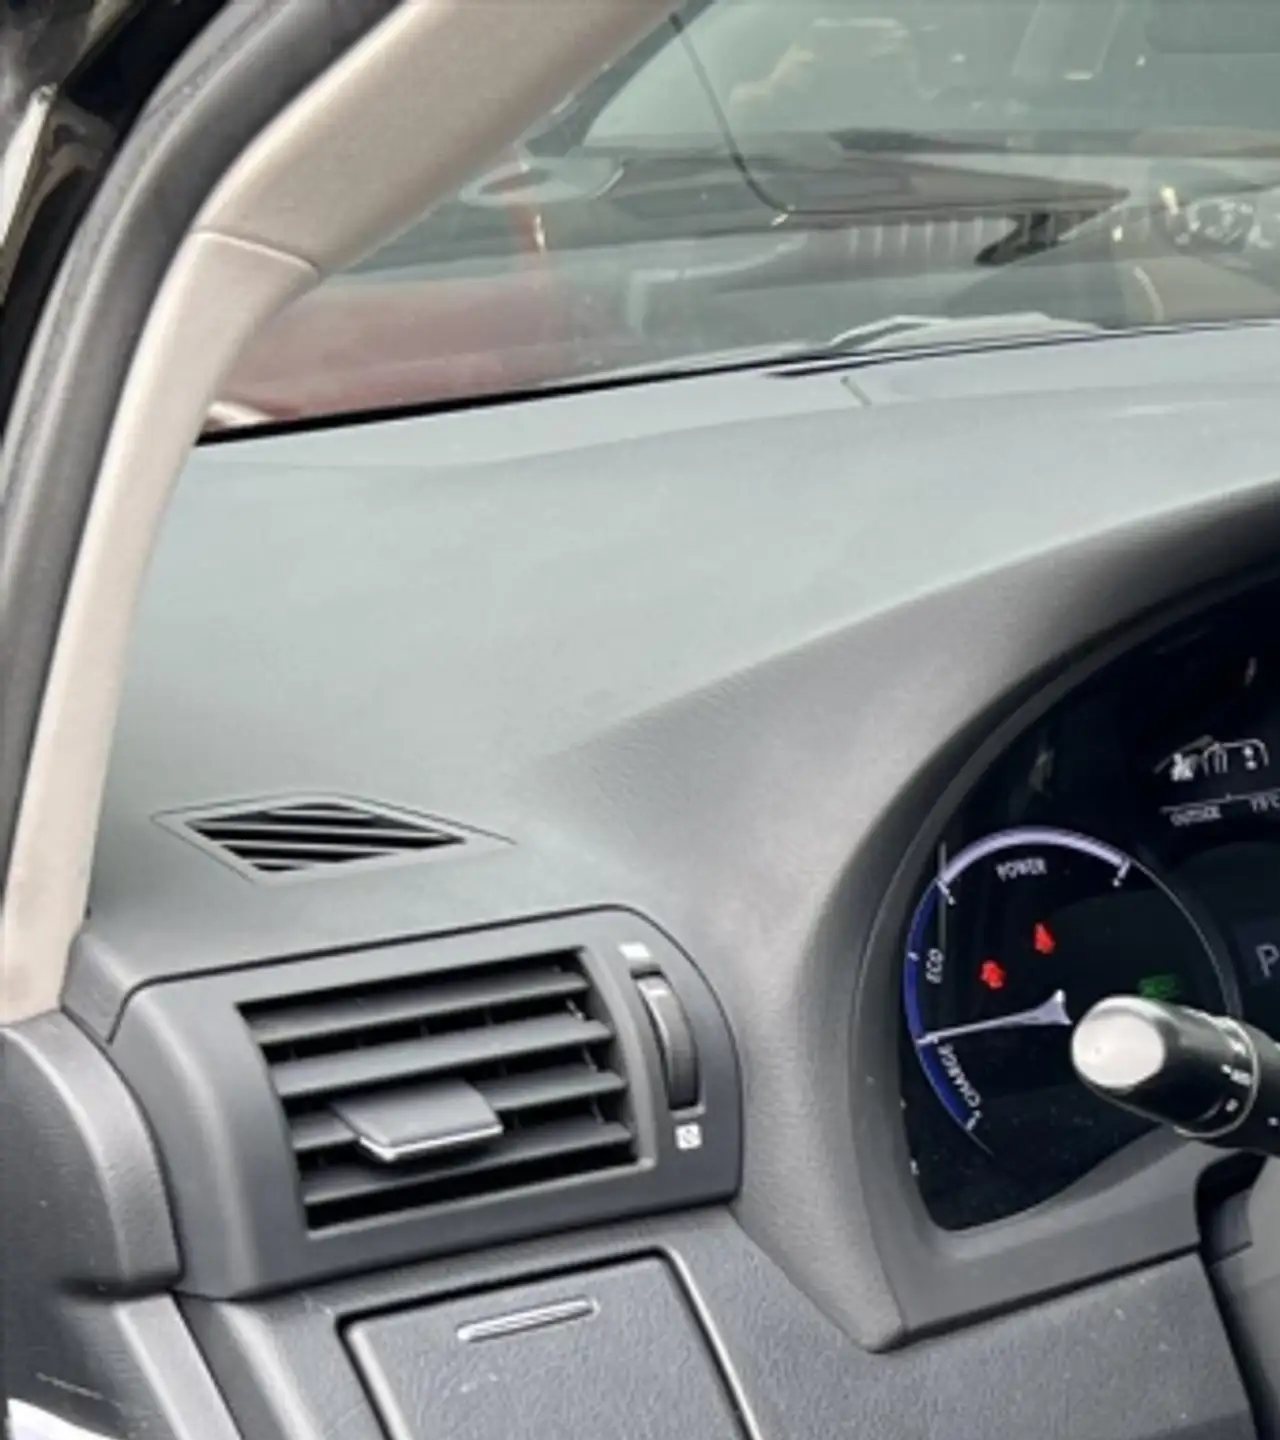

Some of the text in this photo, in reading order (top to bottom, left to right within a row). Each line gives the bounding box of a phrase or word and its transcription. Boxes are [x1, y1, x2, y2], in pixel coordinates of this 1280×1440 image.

[996, 857, 1047, 881] POWER
[1256, 943, 1280, 978] P
[937, 1043, 982, 1109] CHARGE
